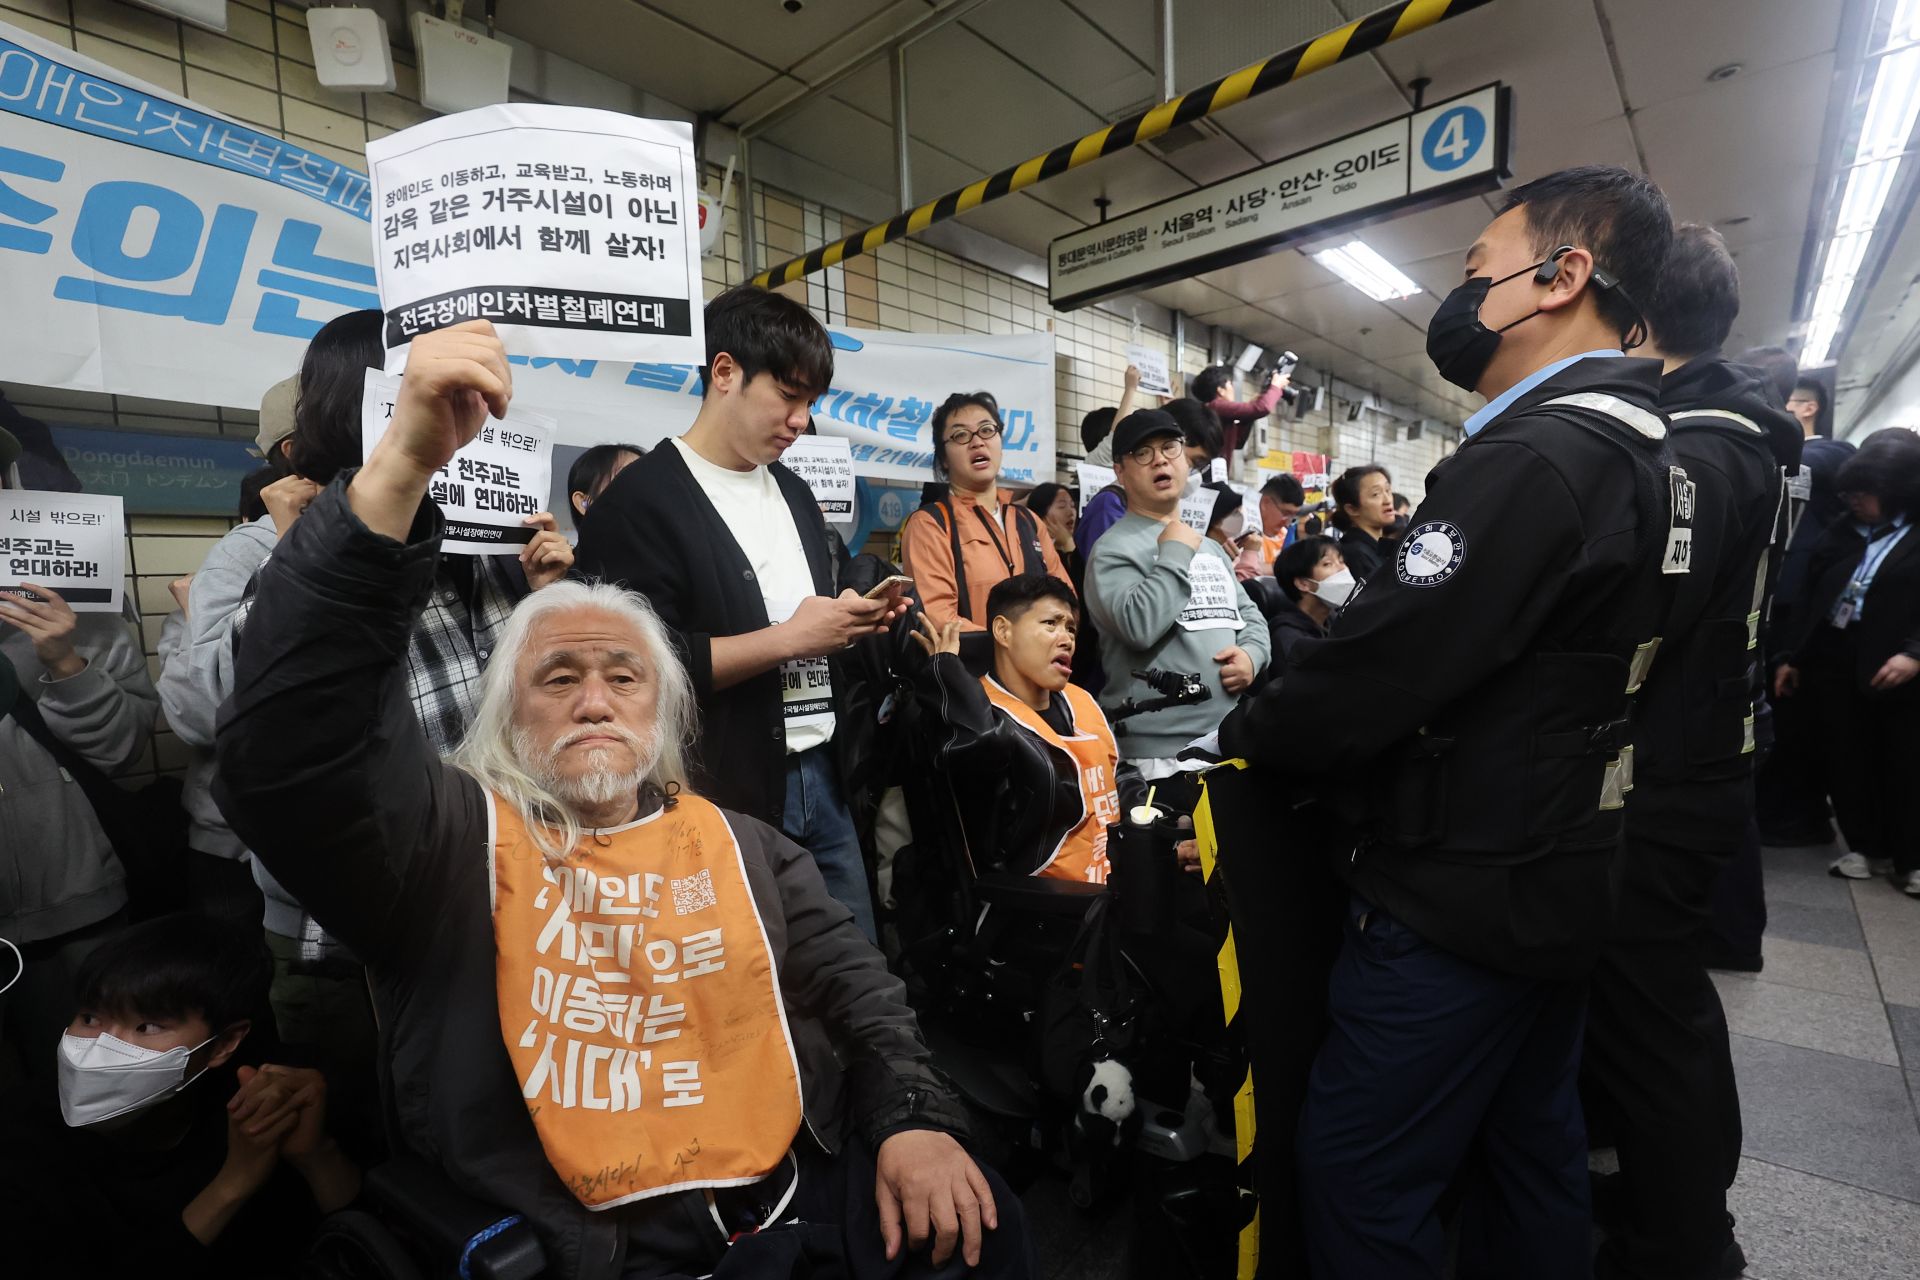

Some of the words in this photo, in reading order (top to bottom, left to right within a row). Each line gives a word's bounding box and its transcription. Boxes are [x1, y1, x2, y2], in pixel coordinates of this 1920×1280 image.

[1433, 113, 1471, 162] 4
[385, 177, 434, 208] 장애인도
[441, 164, 506, 188] 이동하고,
[515, 163, 594, 184] 교육받고,
[603, 169, 673, 193] 노동하며
[1161, 205, 1213, 236] 서울역
[1226, 187, 1268, 215] 사당
[1279, 168, 1324, 199] 안산
[1332, 143, 1400, 182] 오이도
[384, 206, 418, 240] 감옥
[429, 193, 470, 225] 같은
[482, 187, 613, 219] 거주시설이
[628, 198, 678, 225] 아닌
[1161, 235, 1184, 249] Seoul
[1187, 226, 1216, 241] Station
[1225, 212, 1259, 229] Sadang
[1281, 195, 1313, 212] Ansan
[1332, 181, 1358, 195] Oido
[393, 225, 522, 270] 지역사회에서
[537, 226, 591, 255] 함께
[605, 231, 666, 260] 살자!
[399, 291, 666, 336] 전국장애인차별철폐연대
[999, 408, 1039, 453] 다.
[62, 446, 216, 471] Dongdaemun
[458, 457, 521, 490] 천주교는
[9, 508, 41, 524] 시설
[431, 481, 466, 508] 설에
[474, 487, 539, 516] 연대하라!
[9, 558, 99, 579] 연대하라!
[530, 965, 688, 1044] 이동하는
